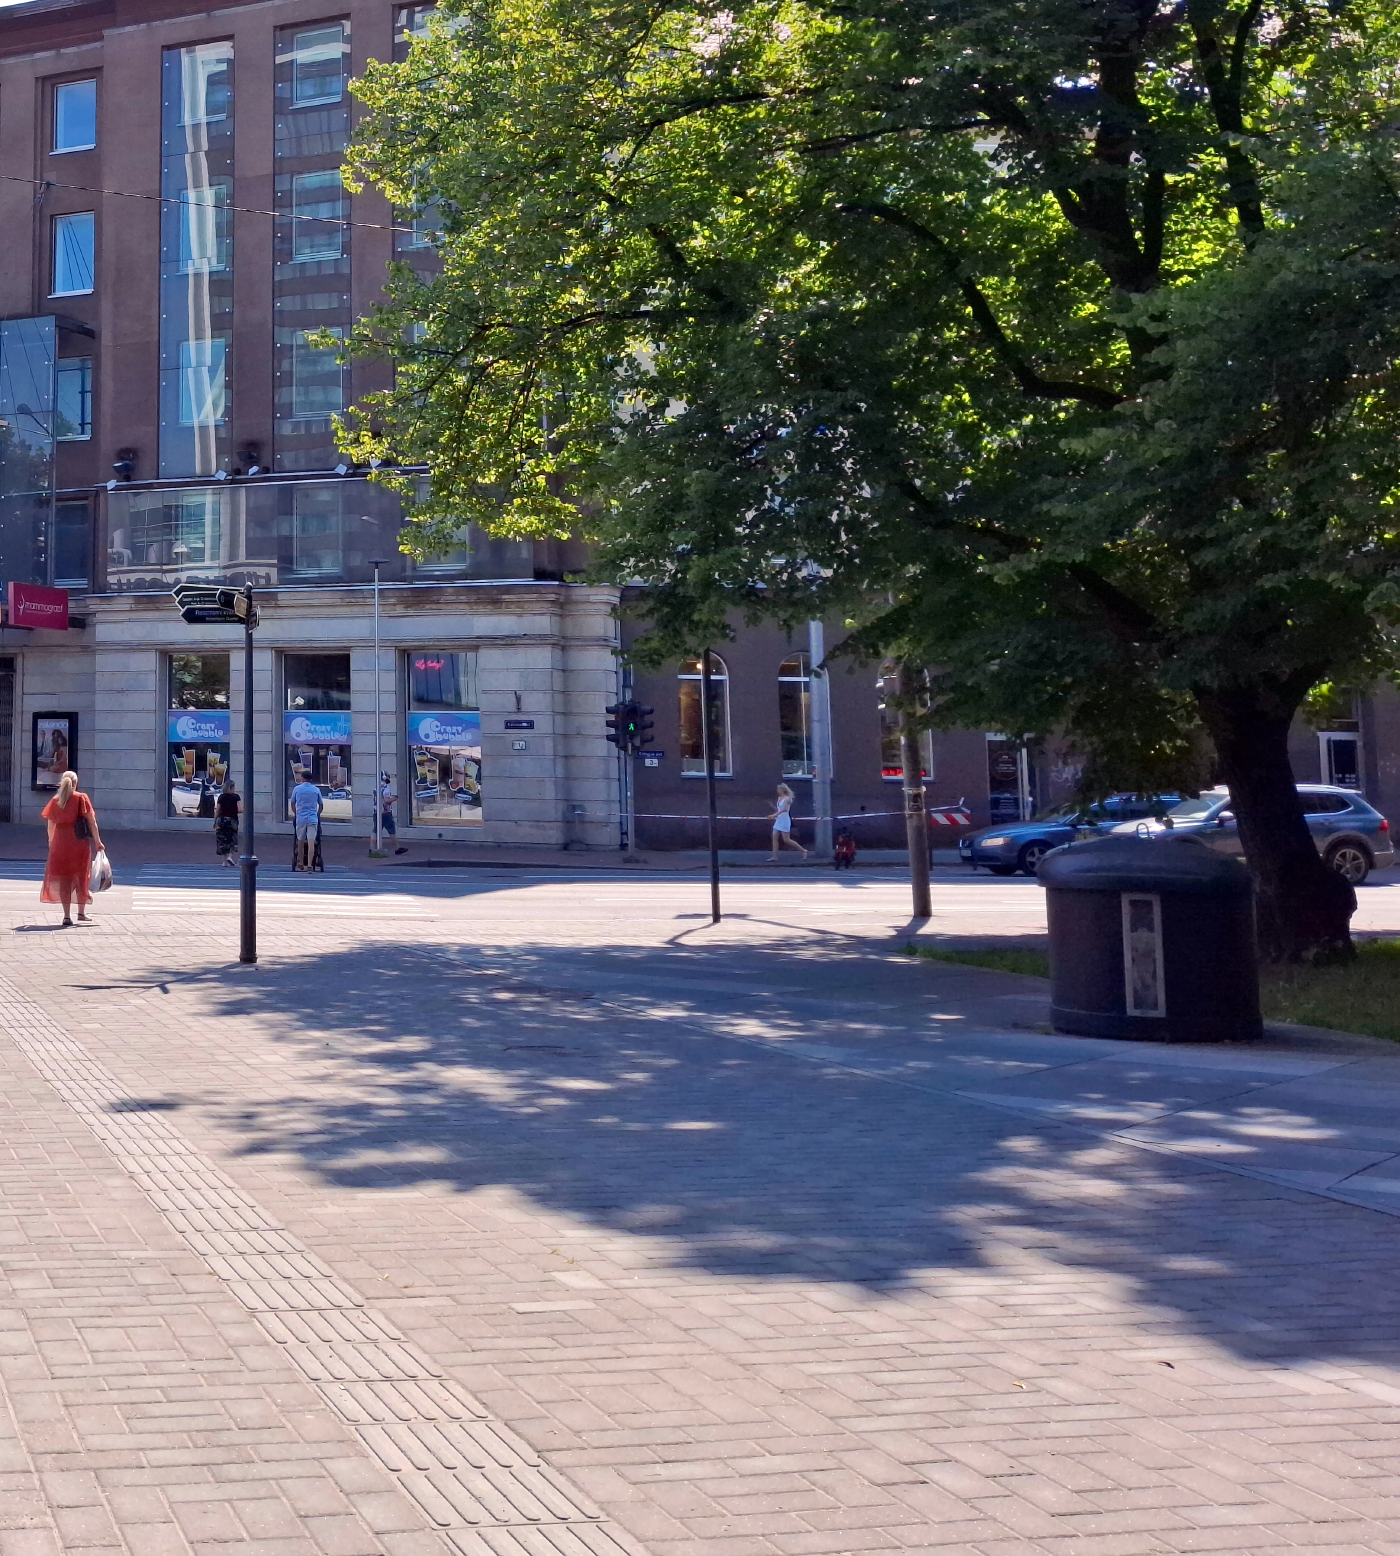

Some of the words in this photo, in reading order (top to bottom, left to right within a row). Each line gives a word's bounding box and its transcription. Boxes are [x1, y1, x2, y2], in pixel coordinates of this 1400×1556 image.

[188, 718, 215, 730] Crazy
[302, 719, 331, 731] Crazy
[430, 720, 462, 732] Crazy
[436, 732, 472, 741] bubble
